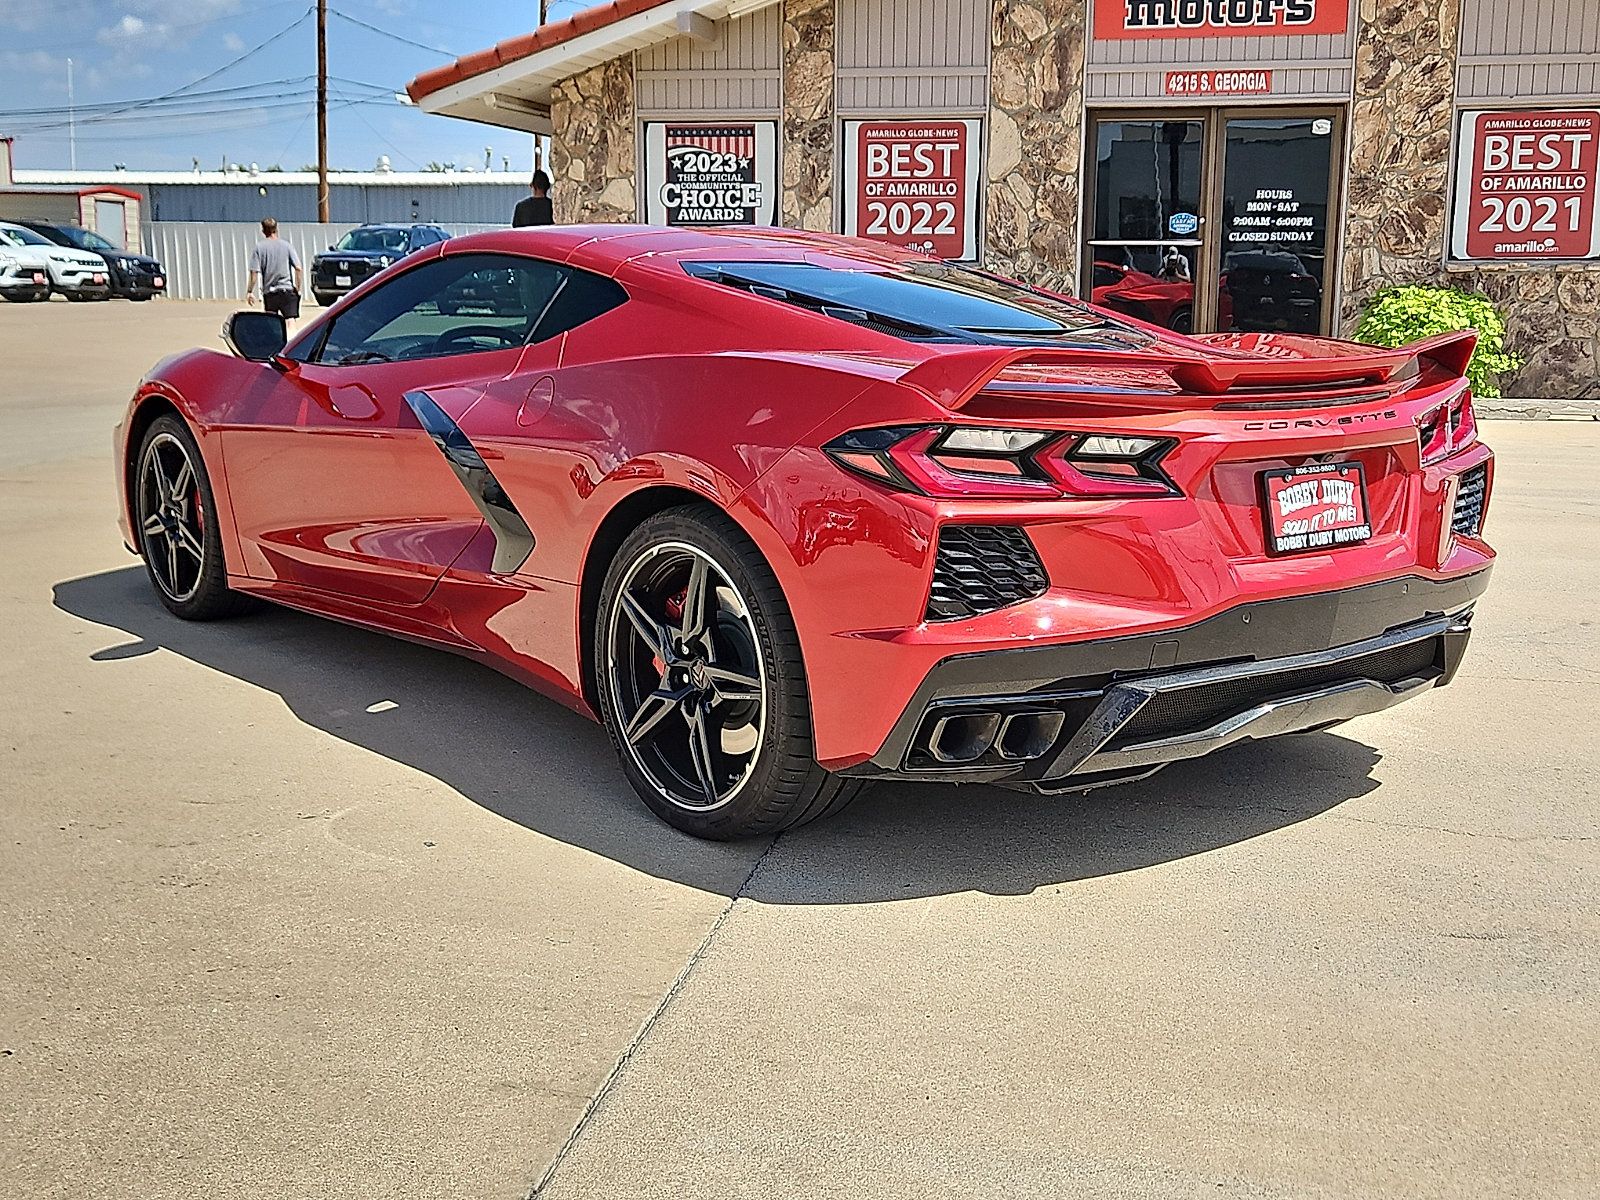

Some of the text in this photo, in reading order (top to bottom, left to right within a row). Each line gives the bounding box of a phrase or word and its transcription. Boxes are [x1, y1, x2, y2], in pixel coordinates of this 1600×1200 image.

[1124, 0, 1318, 29] motors
[1169, 72, 1266, 91] 4215 S. GEORGIA
[866, 129, 959, 138] AMARILLO GLOBE-NEWS
[1485, 119, 1592, 129] AMARILLO GLOBE-NEWS
[684, 153, 737, 172] 2023
[867, 143, 959, 177] BEST
[1483, 134, 1592, 171] BEST
[866, 183, 957, 196] OF AMARILLO
[1480, 176, 1586, 190] OF AMARILLO
[660, 183, 762, 208] CHOICE
[1256, 190, 1293, 199] HOURS
[678, 208, 744, 220] AWARDS
[866, 201, 956, 235] 2022
[1479, 196, 1581, 232] 2021
[1228, 232, 1314, 241] CLOSED SUNDAY
[1494, 240, 1559, 253] amarillo.com
[1243, 410, 1397, 432] CORVETTE
[1277, 479, 1355, 517] BOBBY DUBY
[1281, 505, 1357, 535] SOLD IT TO ME!
[1276, 525, 1371, 551] BOBBY DUBY MOTORS
[748, 595, 777, 678] MICHELIN
